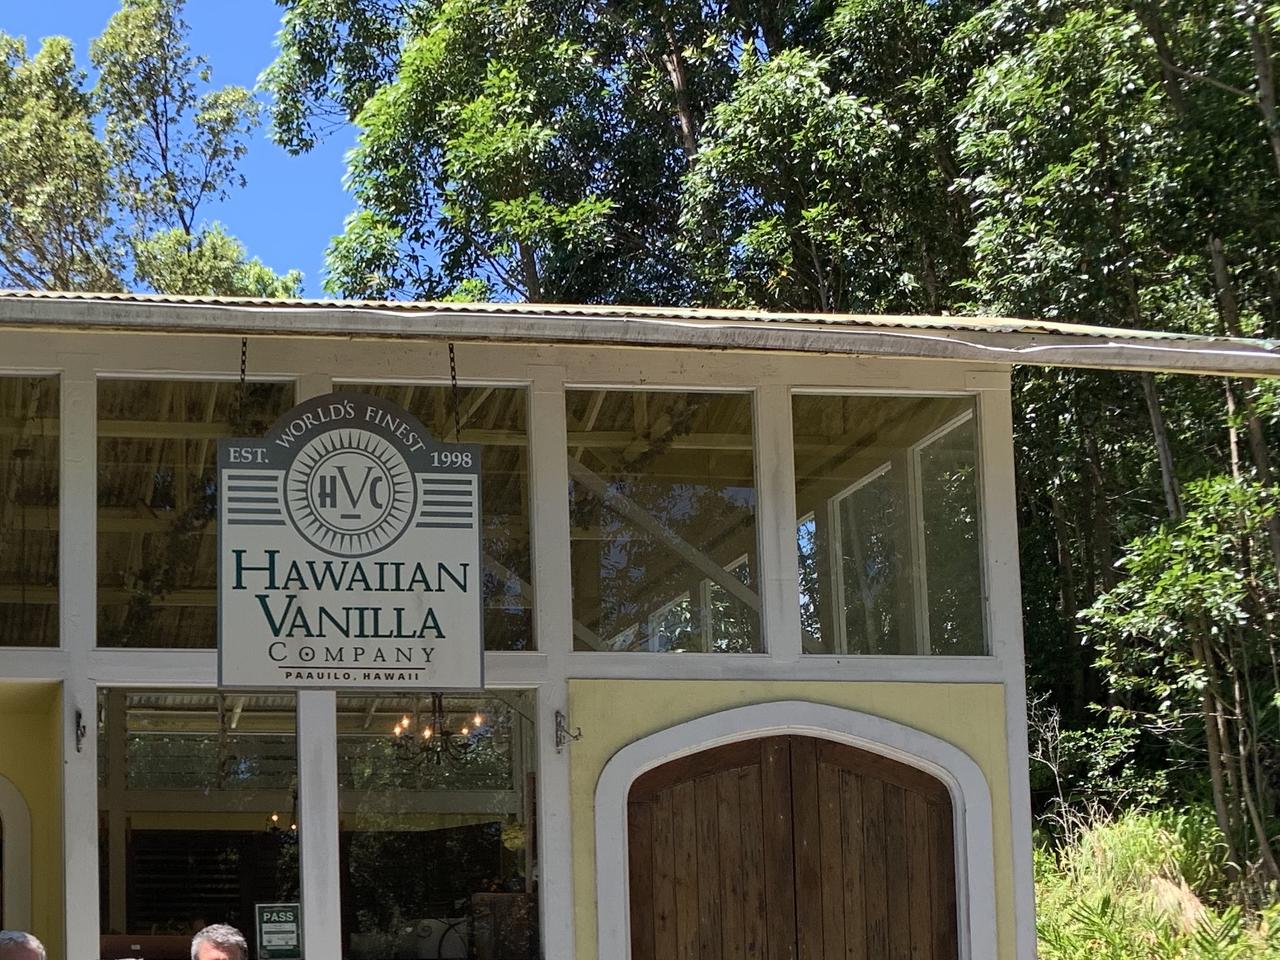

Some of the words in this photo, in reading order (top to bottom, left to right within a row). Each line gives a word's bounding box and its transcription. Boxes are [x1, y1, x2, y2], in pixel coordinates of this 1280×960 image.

[275, 399, 356, 450] WORLD'S
[365, 406, 426, 453] FINEST
[228, 447, 270, 464] EST.
[430, 451, 473, 467] 1998
[231, 549, 470, 594] HAWAIIAN
[254, 594, 447, 639] VANILLA
[268, 641, 436, 664] COMPANY
[363, 672, 420, 682] HAWAII
[263, 912, 294, 921] PASS
